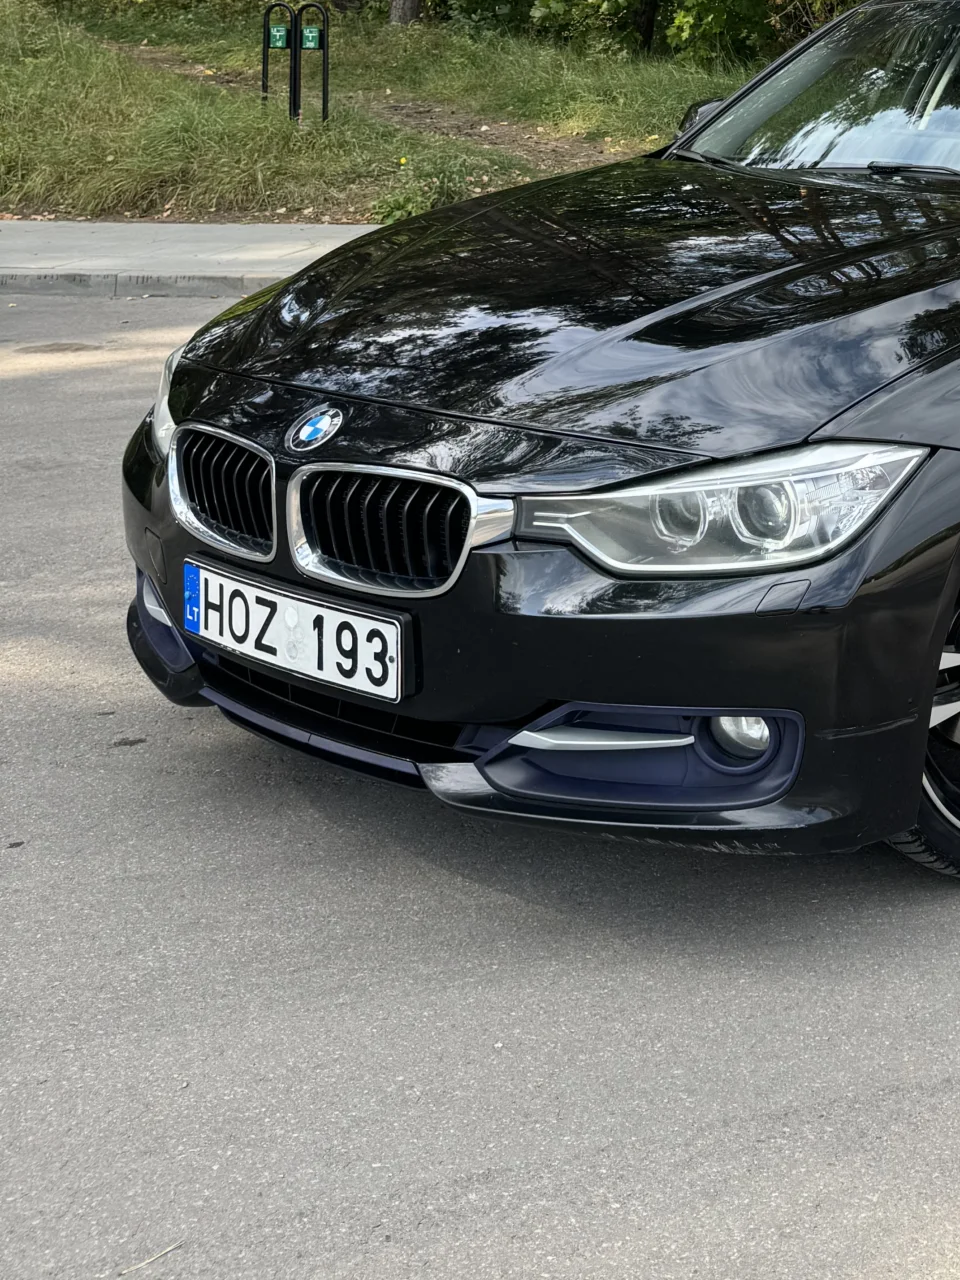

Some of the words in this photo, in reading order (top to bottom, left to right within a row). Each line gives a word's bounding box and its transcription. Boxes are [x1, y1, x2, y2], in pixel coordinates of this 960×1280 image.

[186, 604, 199, 622] LT
[204, 577, 278, 656] HOZ
[312, 614, 389, 687] 193
